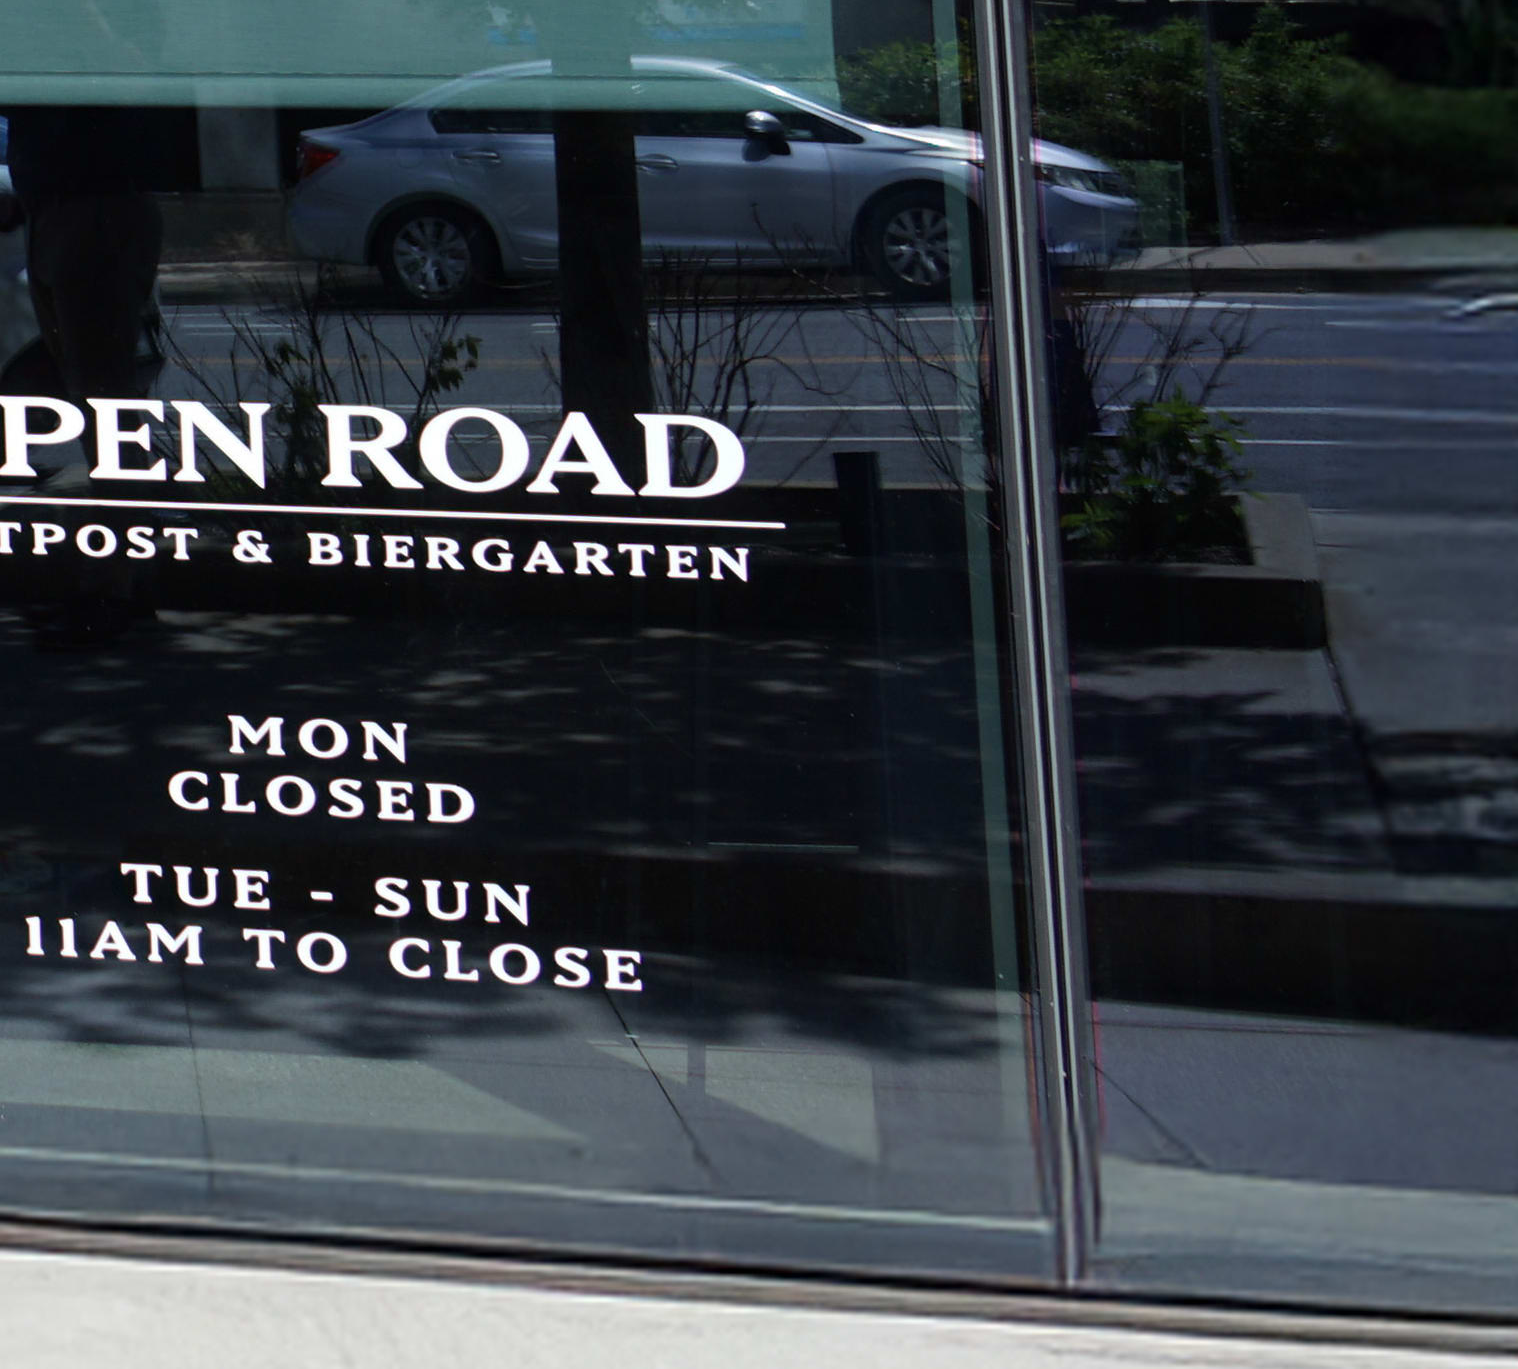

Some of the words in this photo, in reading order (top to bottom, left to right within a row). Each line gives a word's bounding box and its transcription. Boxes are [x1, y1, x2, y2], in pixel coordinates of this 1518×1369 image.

[316, 403, 746, 499] ROAD
[231, 529, 273, 564] &
[306, 531, 750, 583] BIERGARTEN
[227, 714, 408, 764] MON
[167, 770, 476, 824] CLOSED
[119, 862, 271, 911] TUE
[309, 890, 334, 902] -
[373, 876, 531, 927] SUN
[24, 915, 205, 966] 11AM
[242, 927, 348, 974] TO
[388, 936, 643, 992] CLOSE
